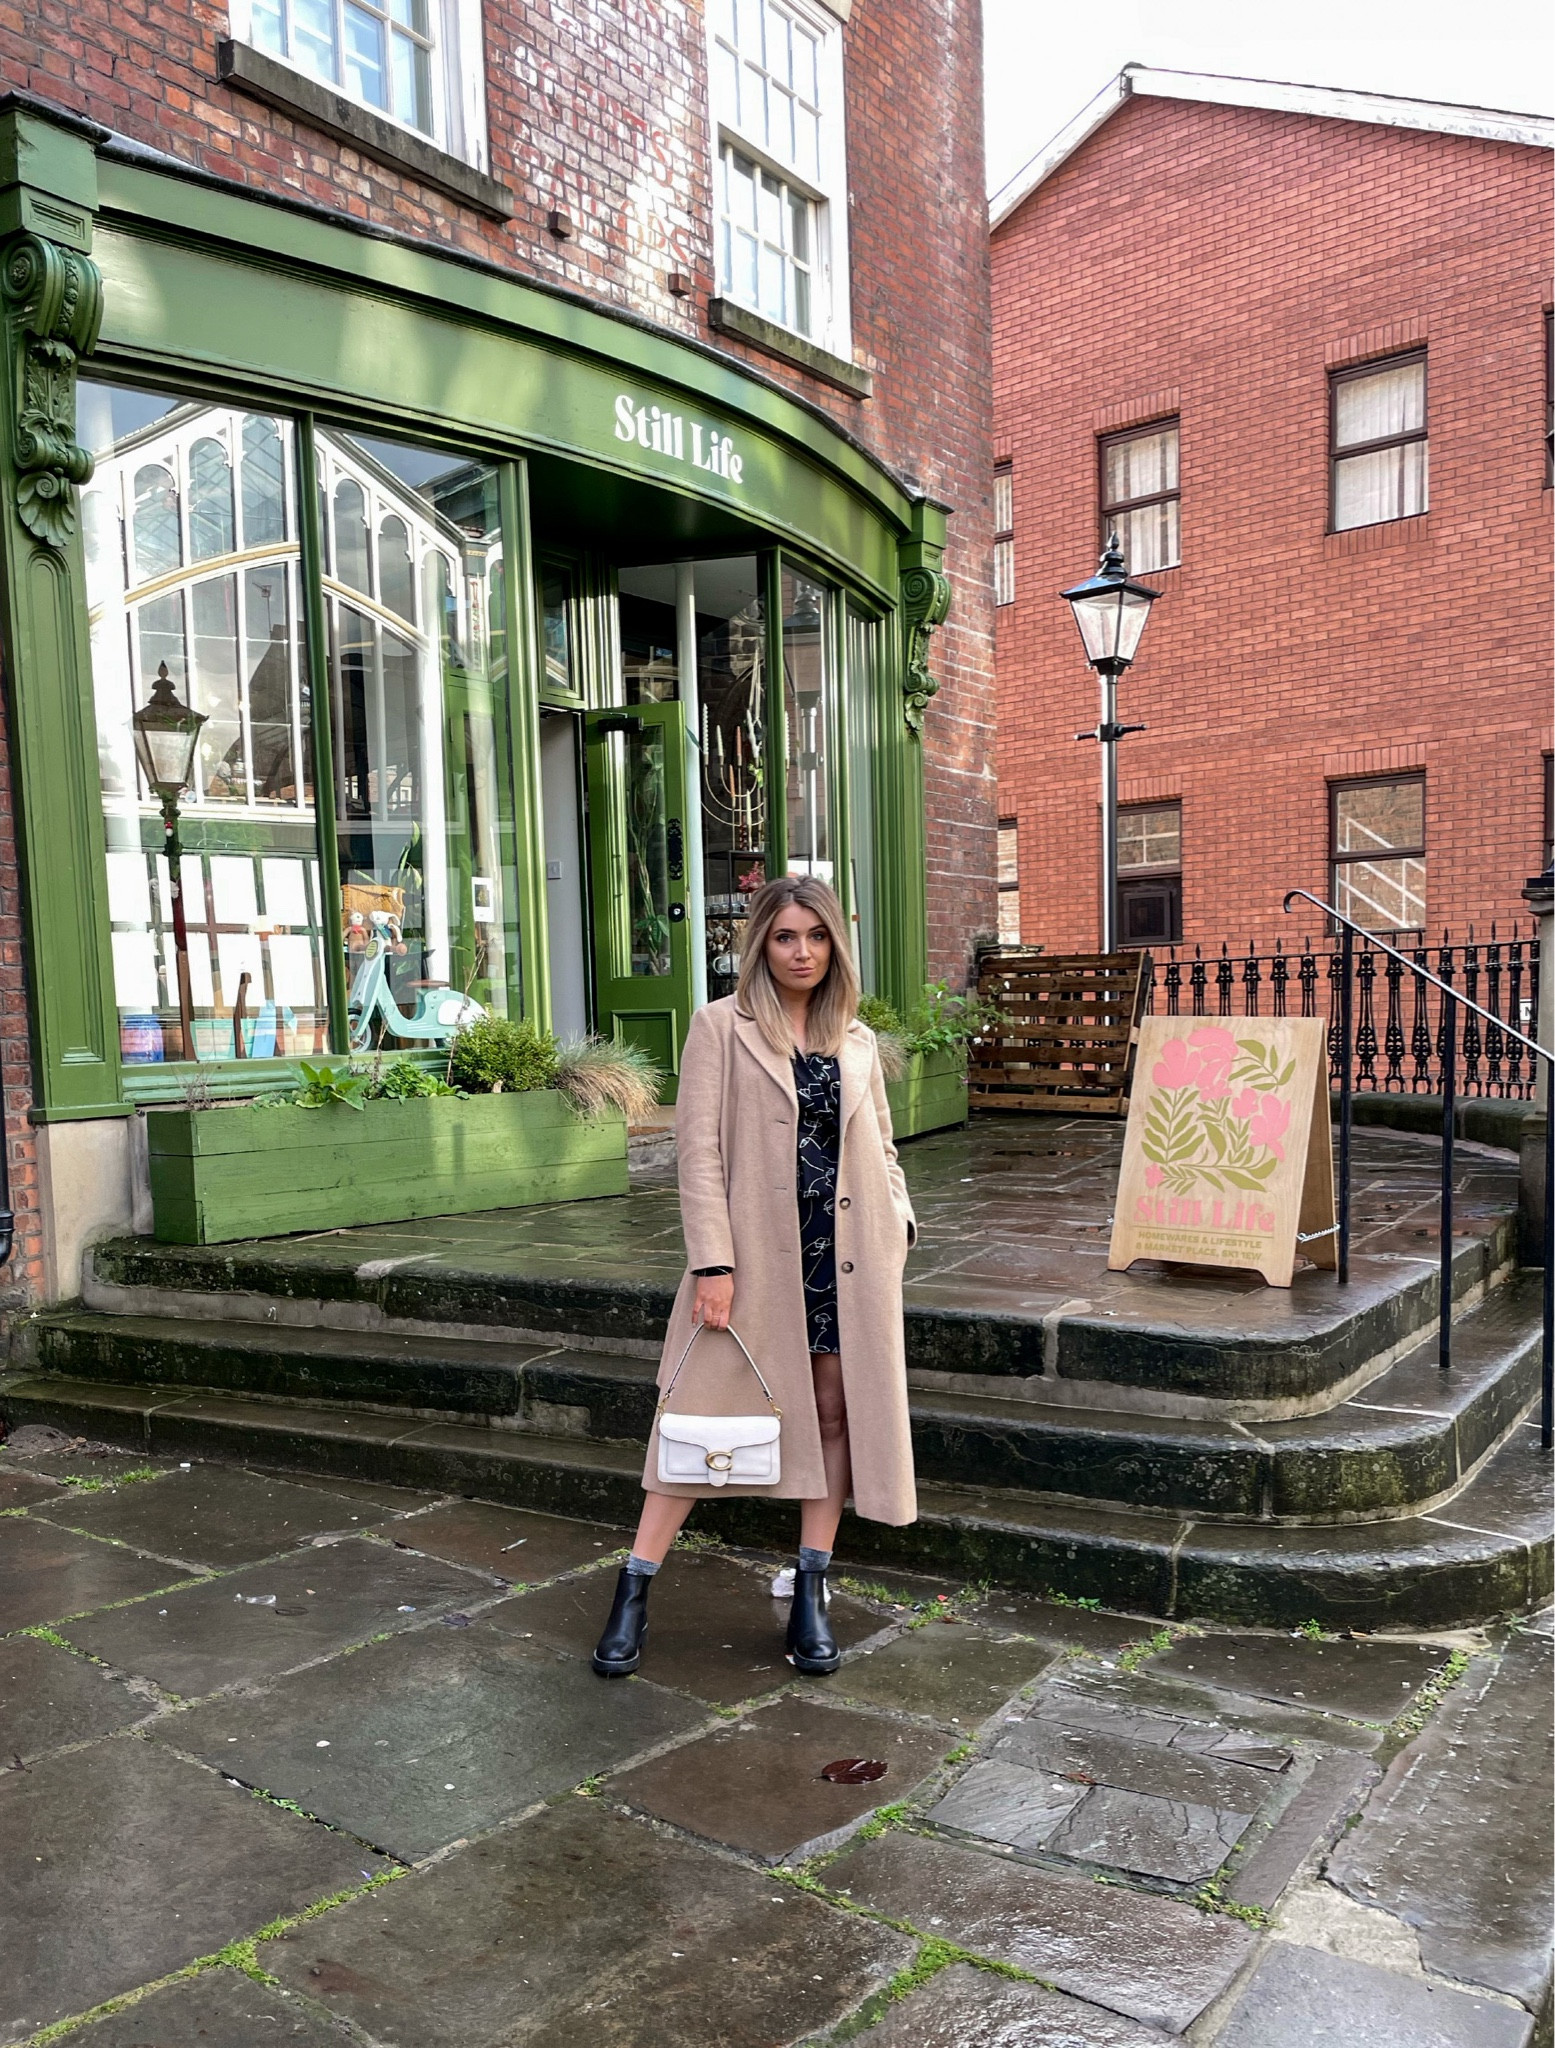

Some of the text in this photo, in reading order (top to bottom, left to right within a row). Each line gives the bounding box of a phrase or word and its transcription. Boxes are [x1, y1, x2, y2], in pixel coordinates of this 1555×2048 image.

[615, 394, 744, 484] Still Life
[1133, 1195, 1275, 1232] Still Life
[1138, 1231, 1262, 1249] HOMEWARES & LIFESTYLE
[1144, 1242, 1184, 1254] MARKET
[1185, 1246, 1219, 1257] PLACE,
